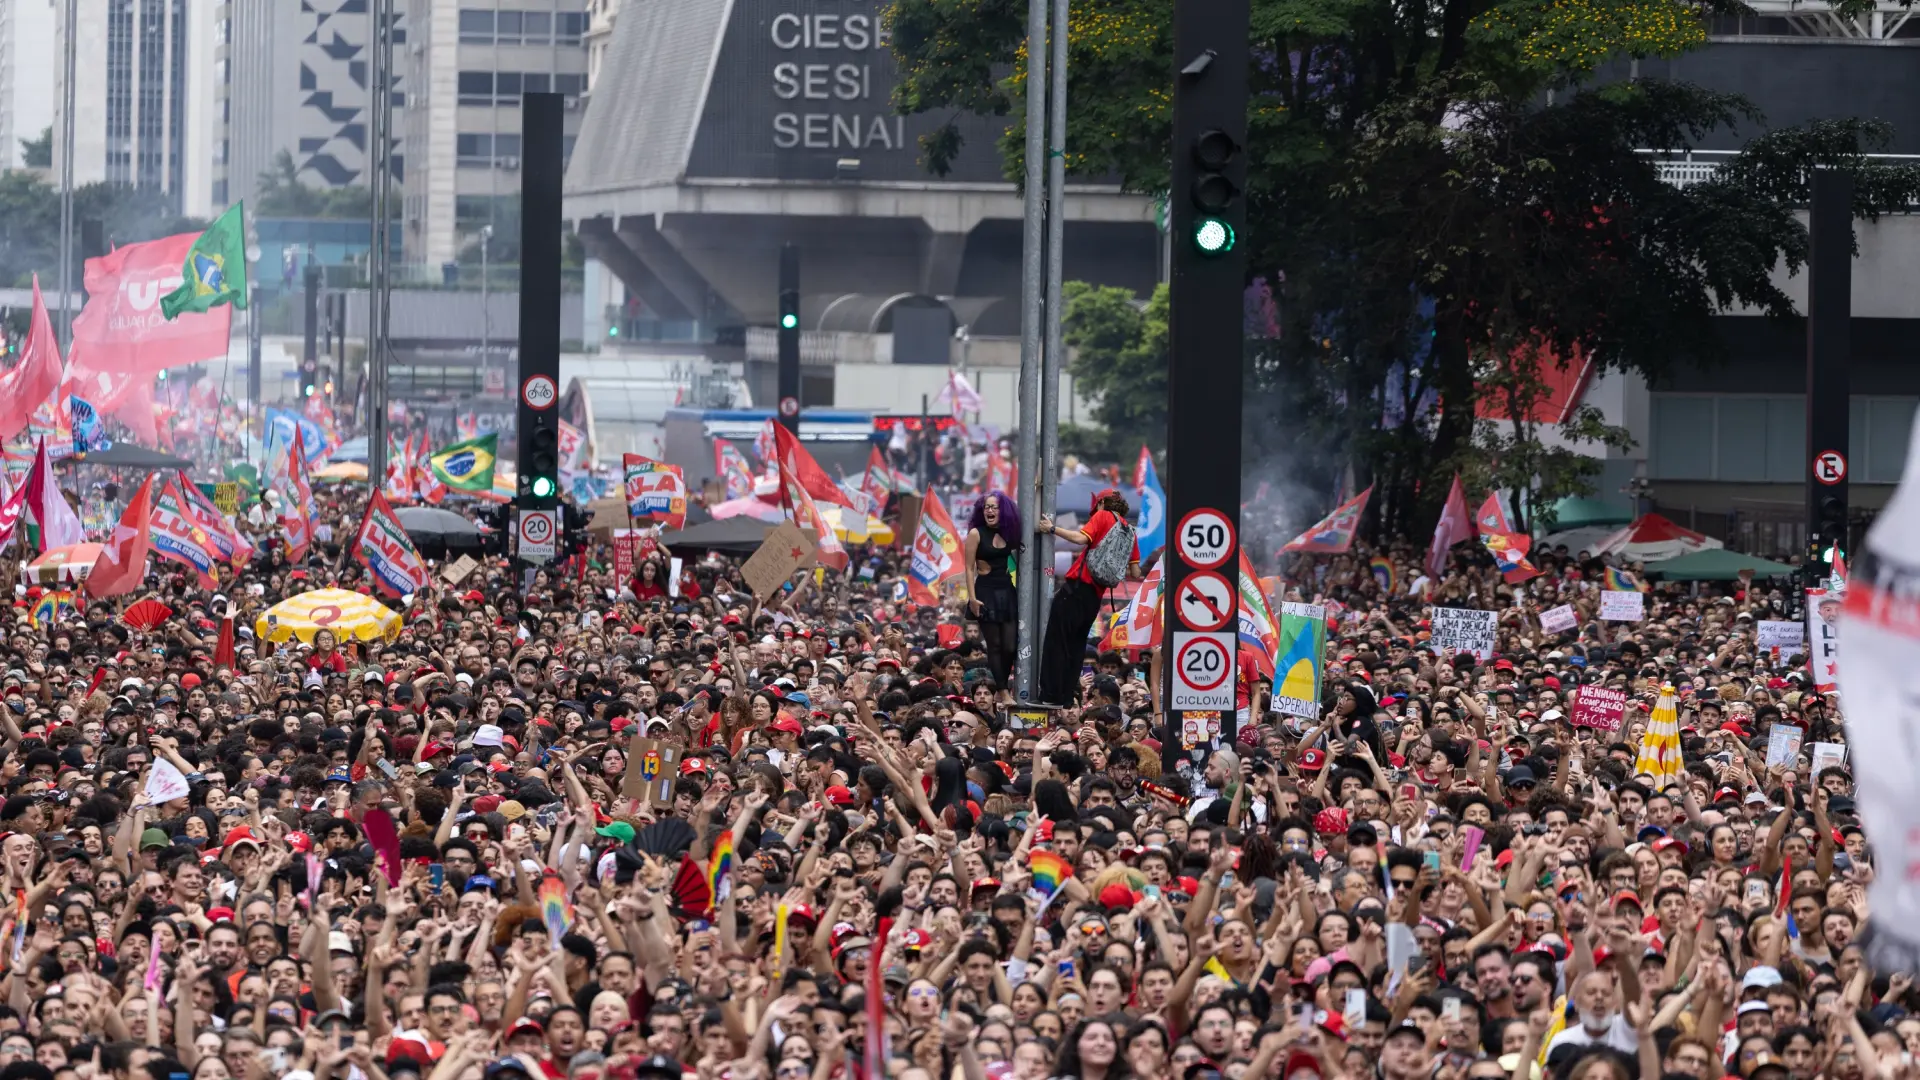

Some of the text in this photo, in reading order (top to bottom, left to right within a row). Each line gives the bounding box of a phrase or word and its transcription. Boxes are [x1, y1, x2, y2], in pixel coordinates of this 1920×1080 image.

[773, 62, 870, 100] SESI
[773, 112, 905, 149] SENAI
[528, 520, 547, 534] 20
[1187, 524, 1225, 549] 50
[1193, 550, 1217, 559] km/h
[1187, 650, 1220, 672] 20
[1194, 674, 1212, 682] km/h
[1176, 695, 1230, 706] CICLOVIA
[1581, 686, 1626, 702] NENHUMA
[1590, 706, 1607, 715] COM
[644, 756, 661, 775] 13
